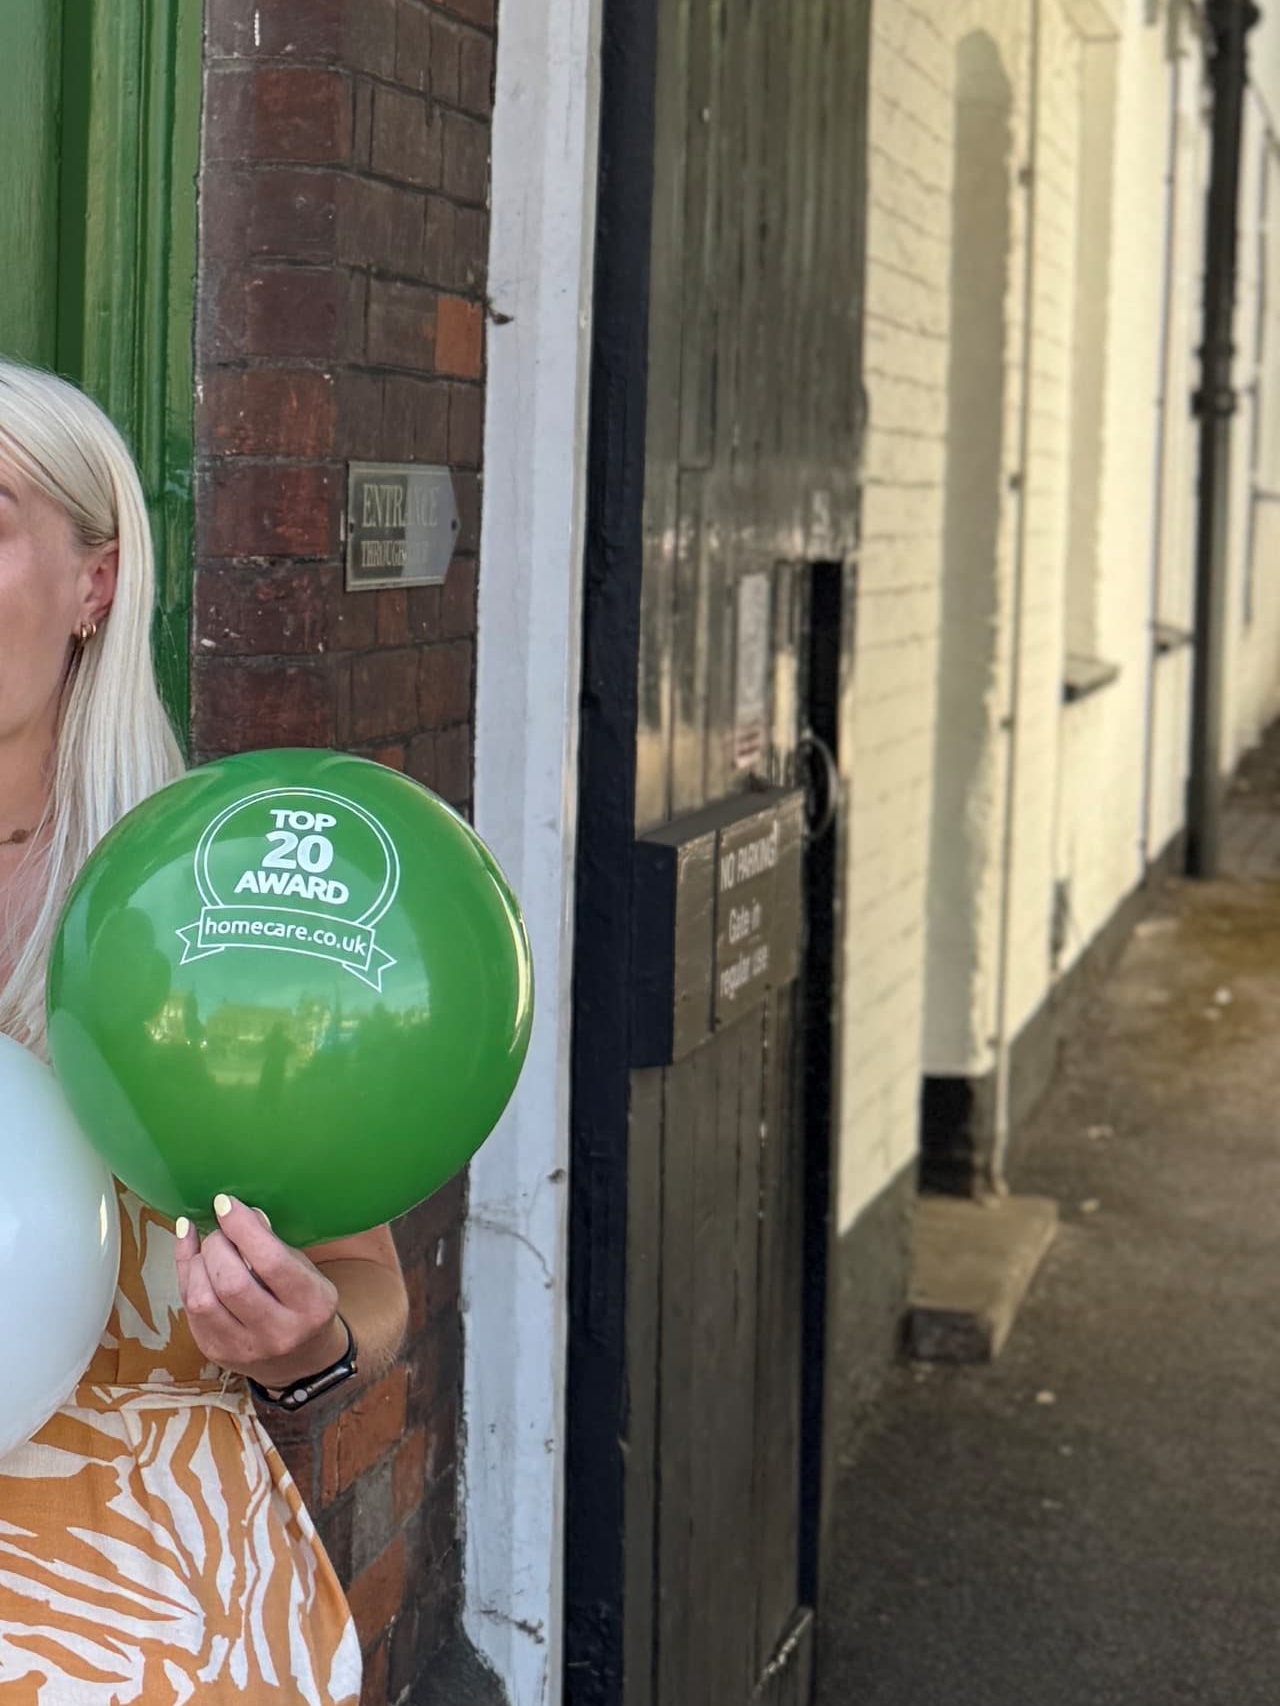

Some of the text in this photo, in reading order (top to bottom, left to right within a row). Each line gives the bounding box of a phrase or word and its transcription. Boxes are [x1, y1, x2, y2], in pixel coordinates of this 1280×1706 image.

[362, 483, 439, 527] ENTRANCE
[270, 809, 336, 831] TOP
[262, 831, 334, 873] 20
[234, 871, 349, 904] AWARD
[721, 852, 734, 892] NO
[205, 917, 367, 956] homecare.co.uk
